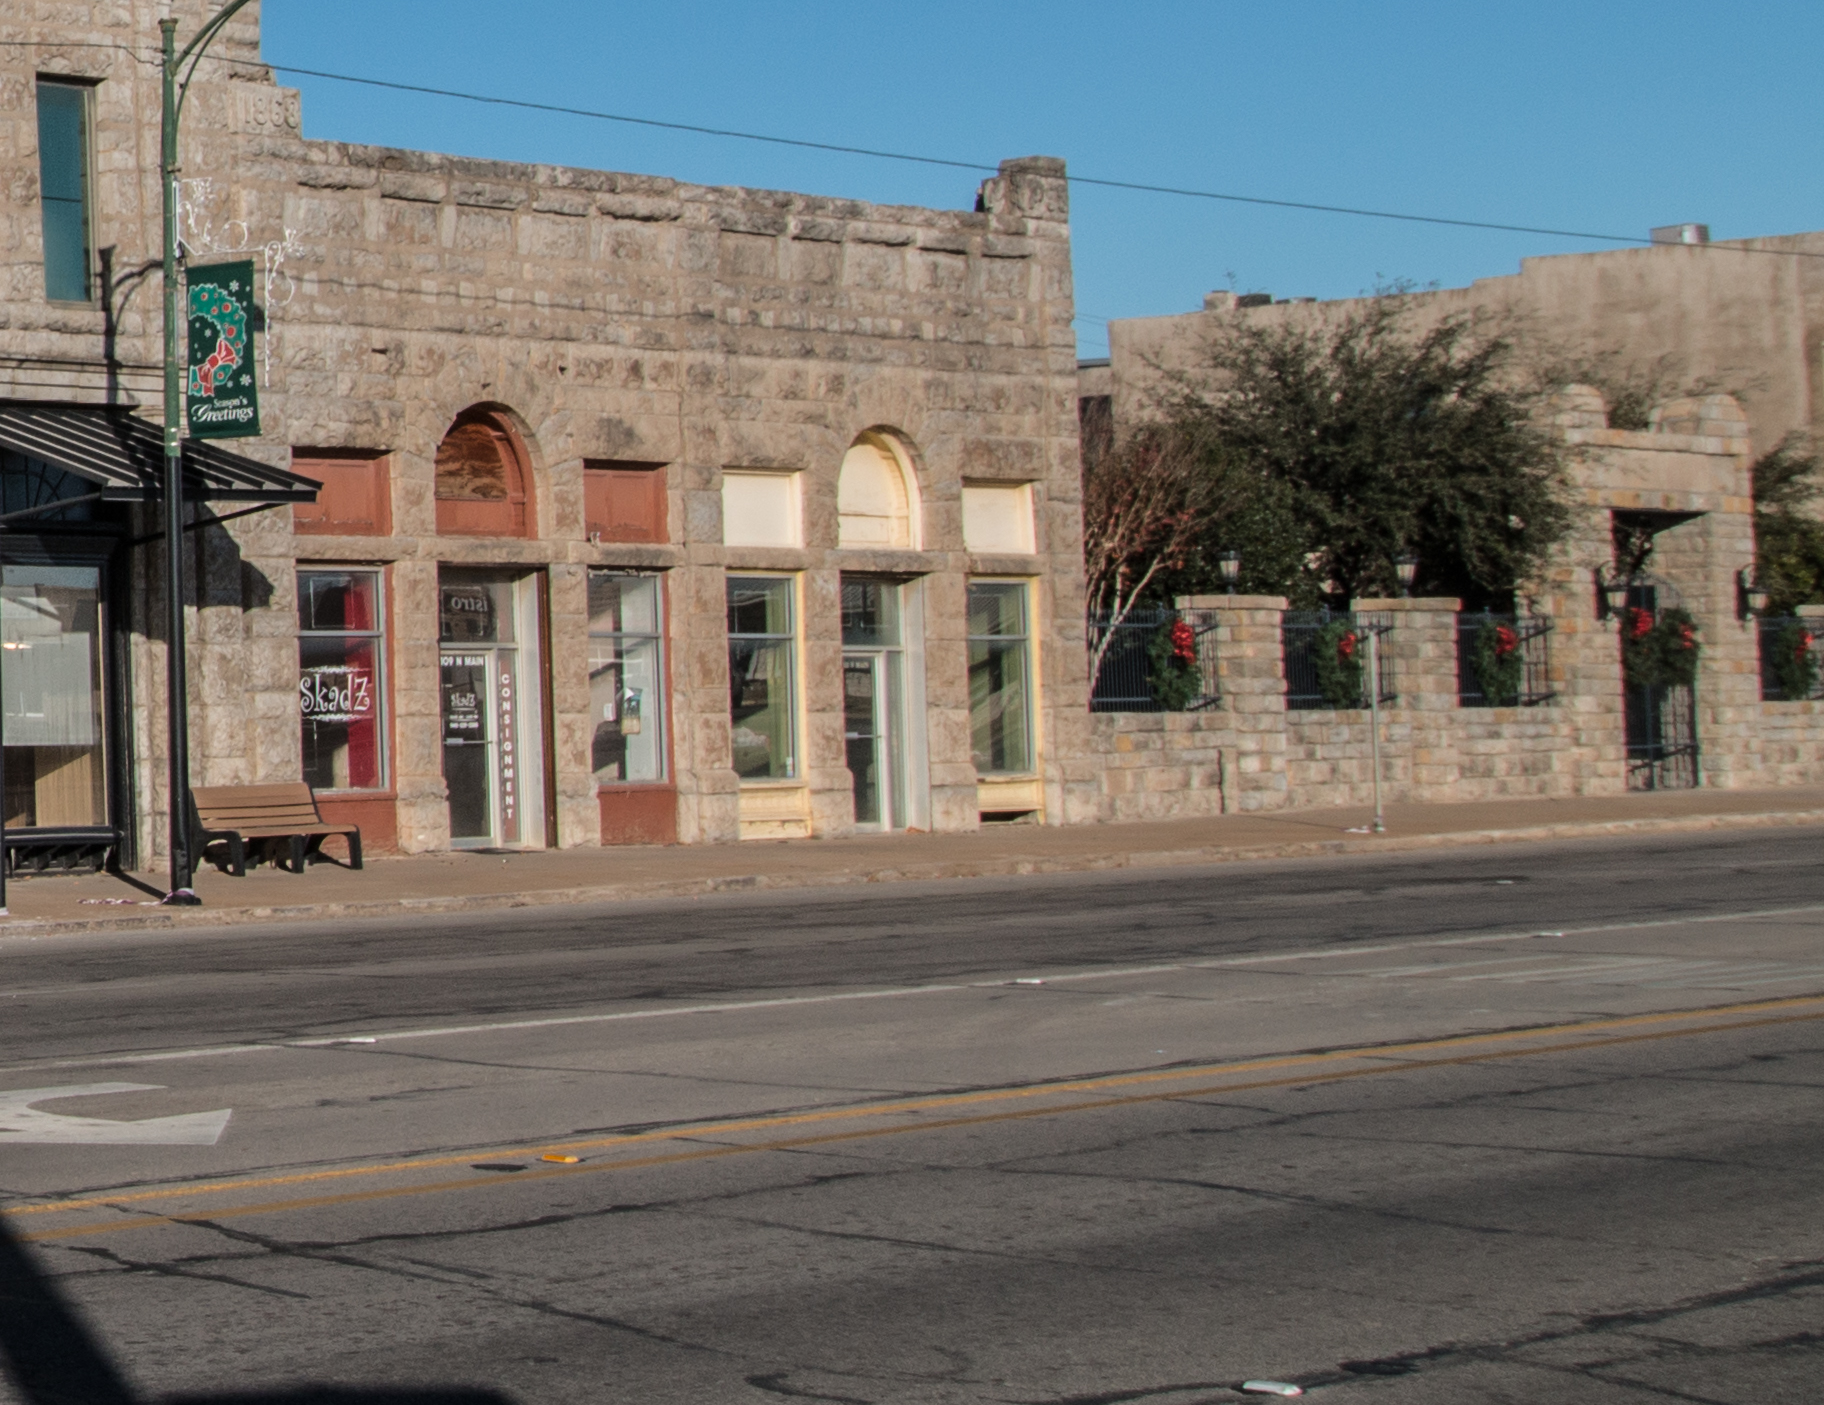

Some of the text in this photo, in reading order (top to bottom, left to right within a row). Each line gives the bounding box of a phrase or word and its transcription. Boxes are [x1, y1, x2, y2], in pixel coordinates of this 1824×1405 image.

[190, 403, 254, 423] Greetings
[464, 656, 484, 666] MAIN
[501, 673, 514, 819] CONSIGNMENT
